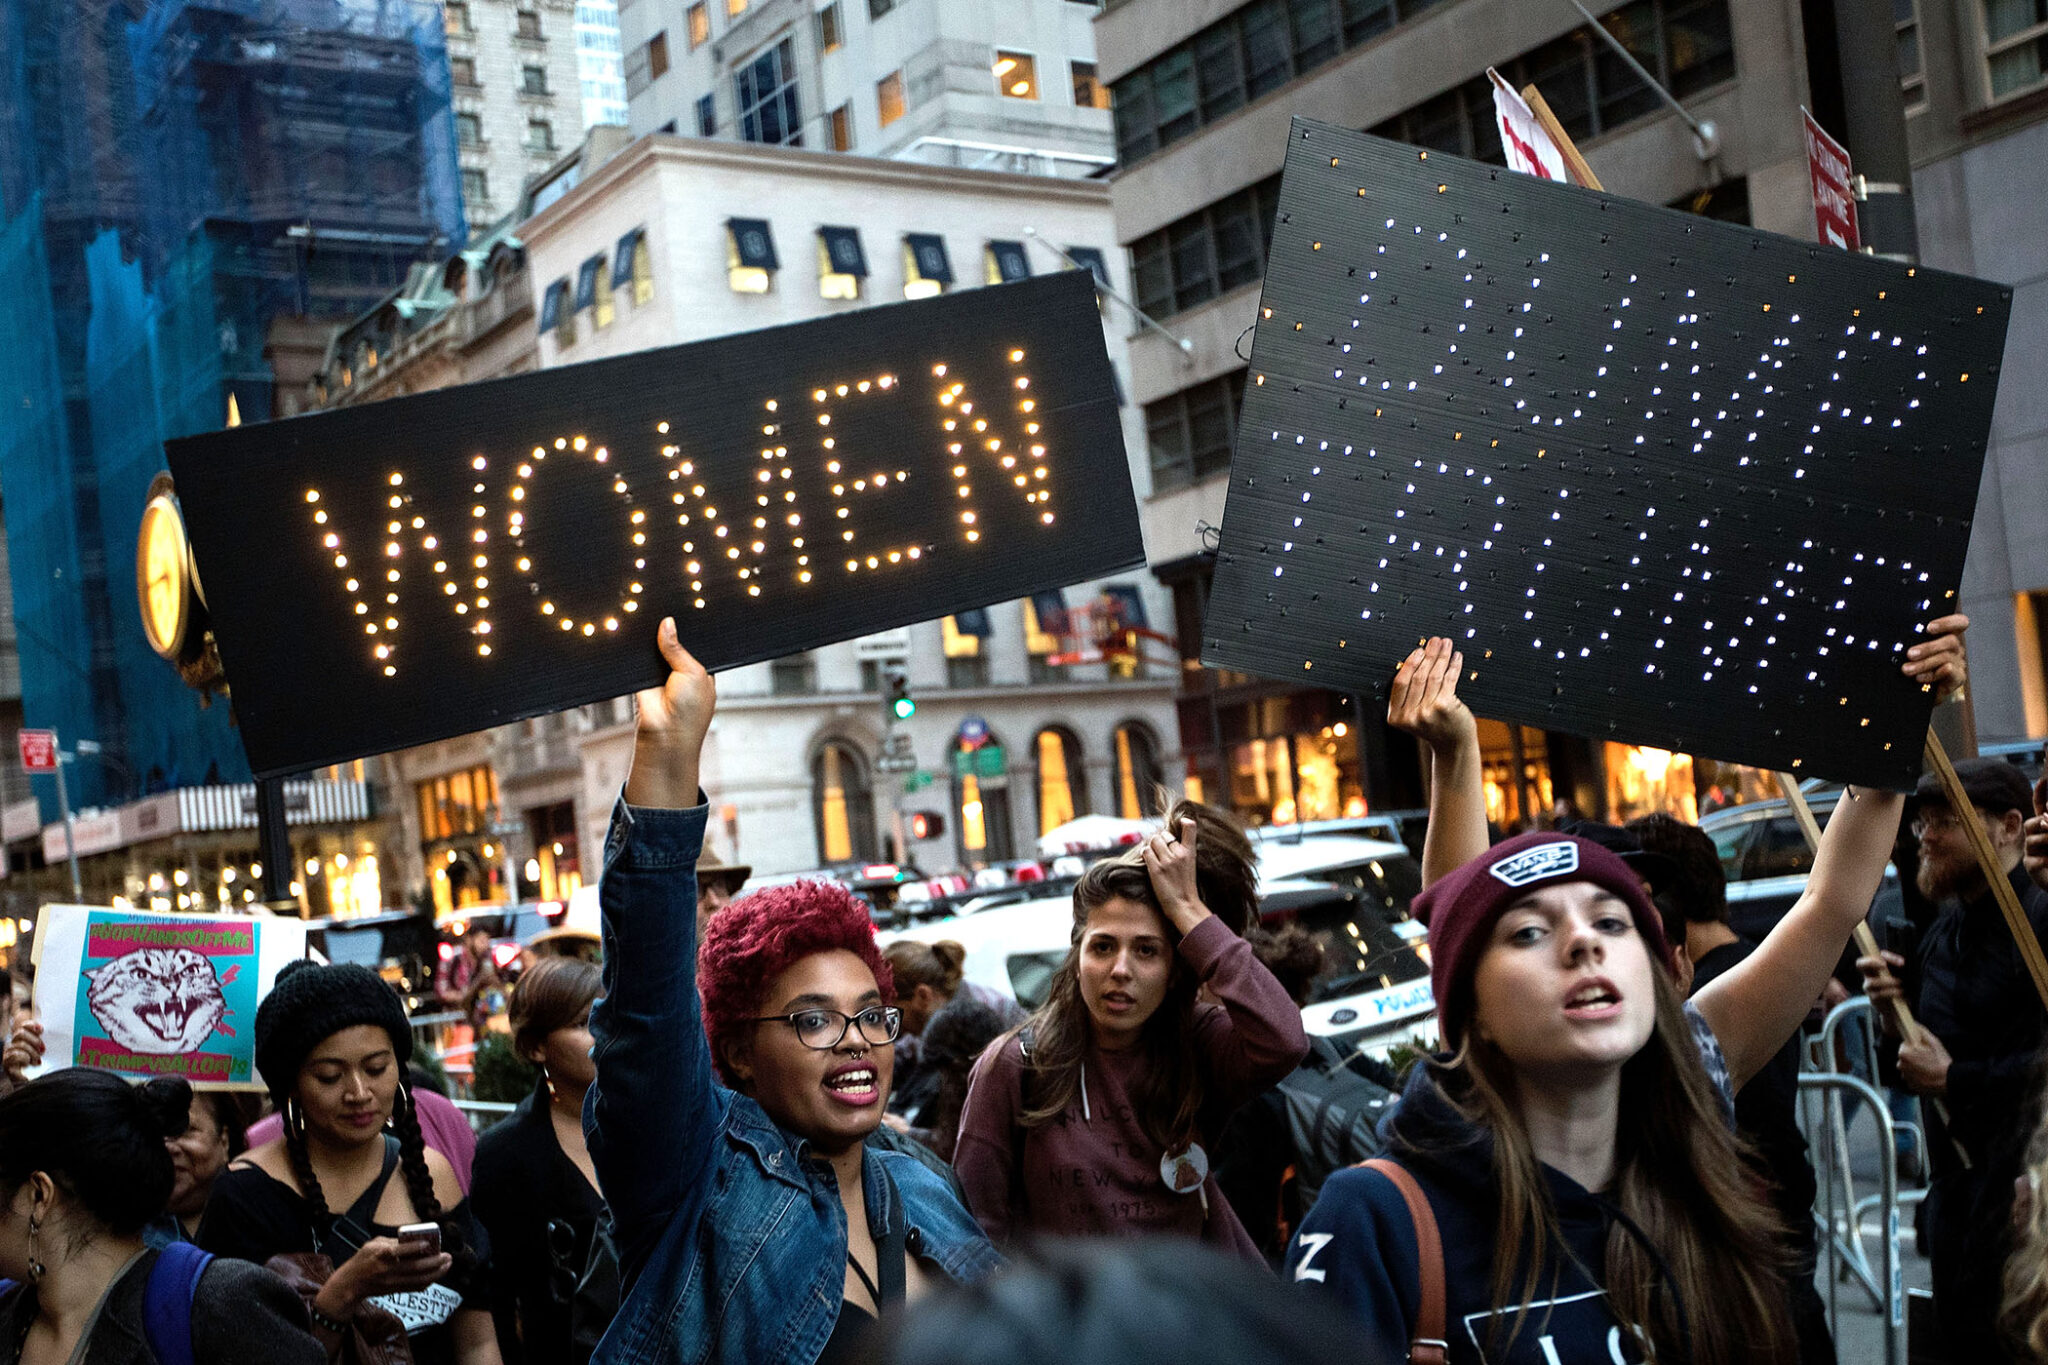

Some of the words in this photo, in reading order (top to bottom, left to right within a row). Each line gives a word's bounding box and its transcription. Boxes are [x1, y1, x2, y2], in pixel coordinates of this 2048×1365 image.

[1333, 218, 1929, 480] DUMP
[303, 348, 1056, 678] WOMEN
[1269, 430, 1933, 696] TRUMP
[1373, 985, 1431, 1015] POLIC
[1050, 1168, 1113, 1188] NEW
